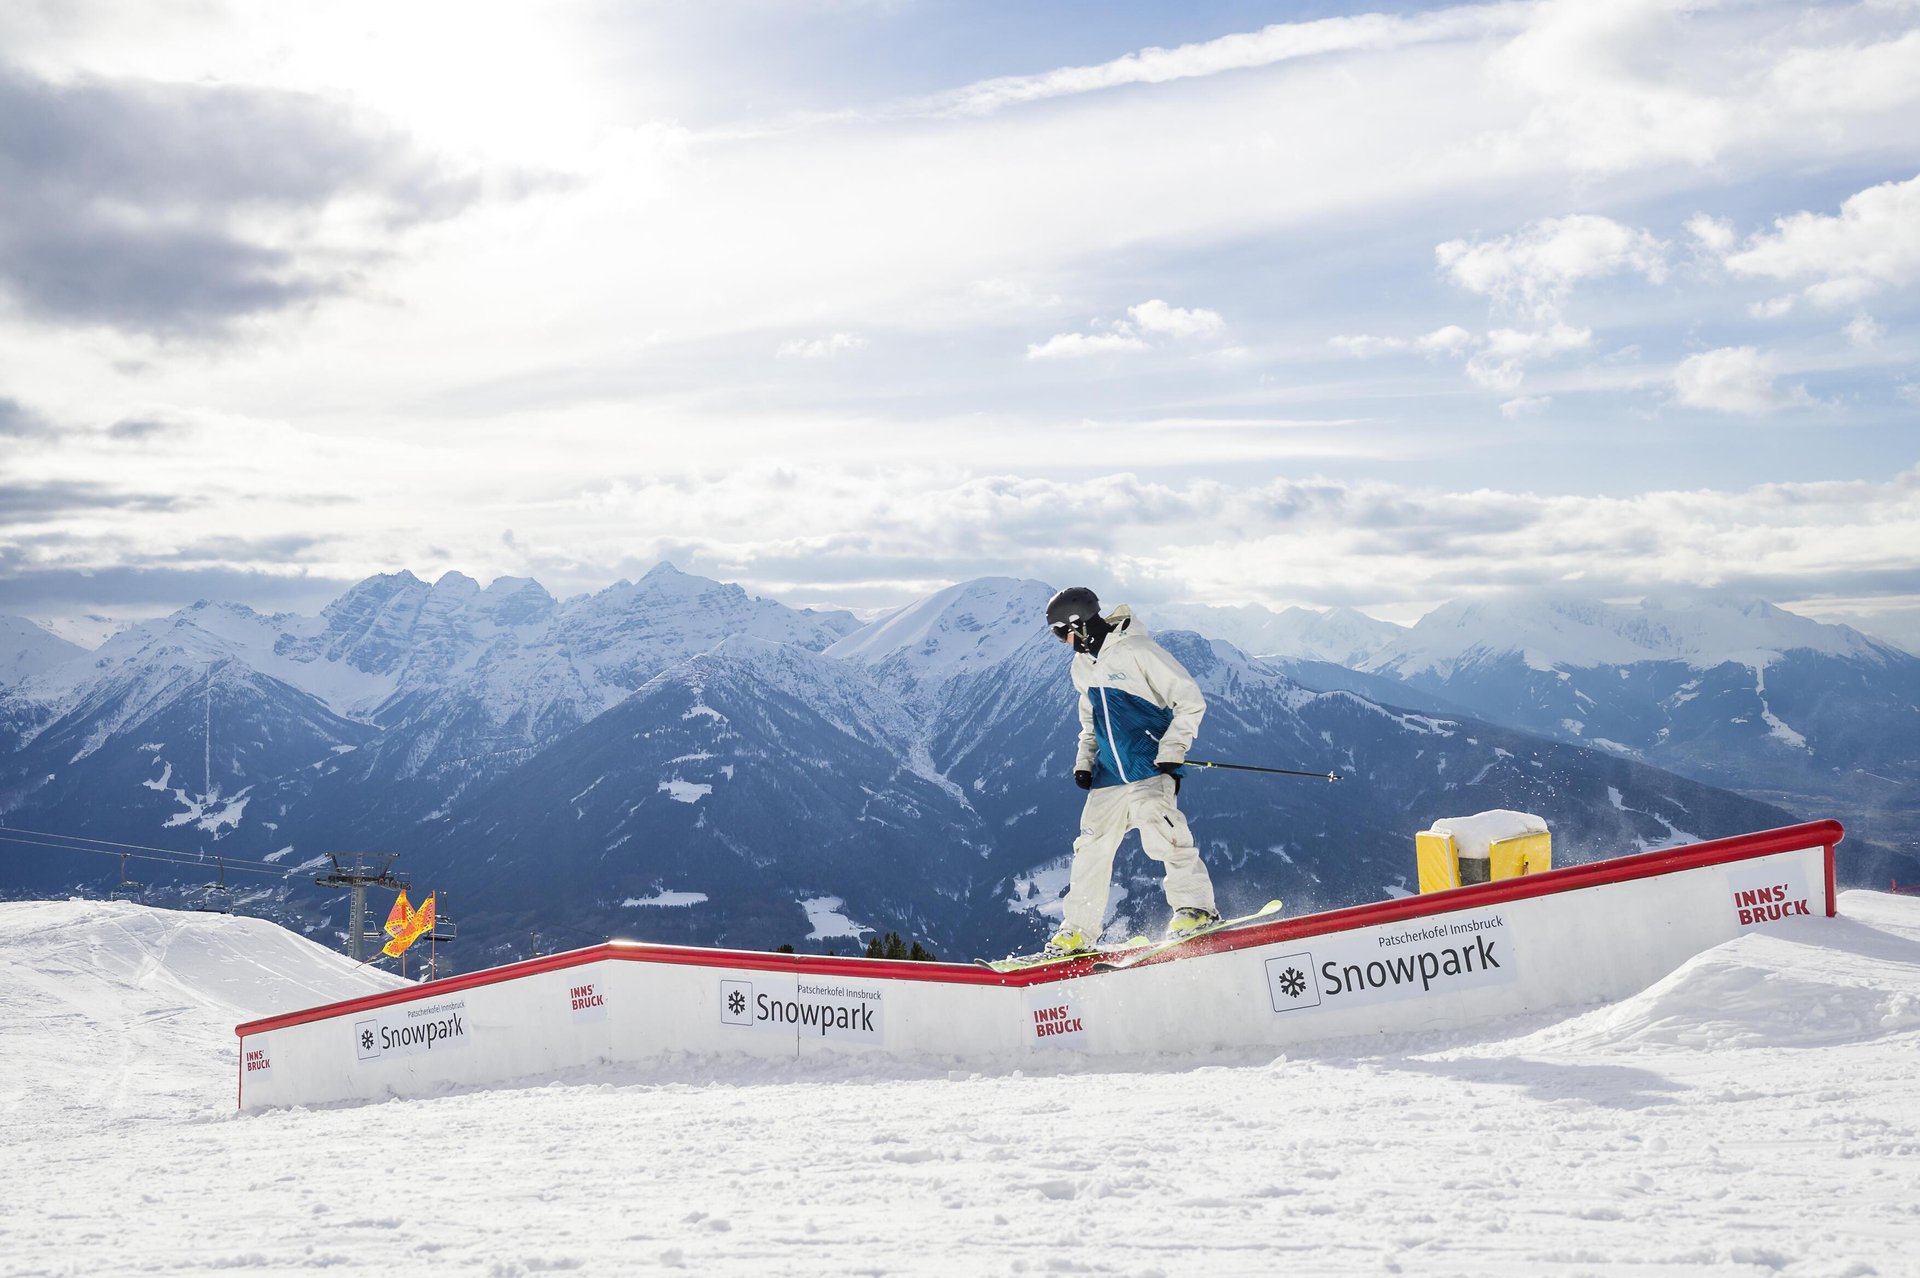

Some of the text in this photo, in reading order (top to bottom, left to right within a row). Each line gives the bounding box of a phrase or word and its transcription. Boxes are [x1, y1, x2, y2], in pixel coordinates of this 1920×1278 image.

[1734, 883, 1788, 908] INNS'
[1738, 899, 1811, 926] BRUCK
[1378, 915, 1503, 948] Patscherkofel Innsbruck
[1321, 935, 1501, 996] Snowpark
[572, 995, 604, 1010] BRUCK
[797, 984, 882, 1001] Patscherkofel Innsbruck
[407, 999, 465, 1018] Patscherkofel Innsbruck
[756, 993, 874, 1036] Snowpark
[1034, 1005, 1069, 1023] INNS'
[381, 1012, 464, 1049] Snowpark
[1036, 1018, 1083, 1037] BRUCK
[247, 1059, 271, 1072] BRUCK
